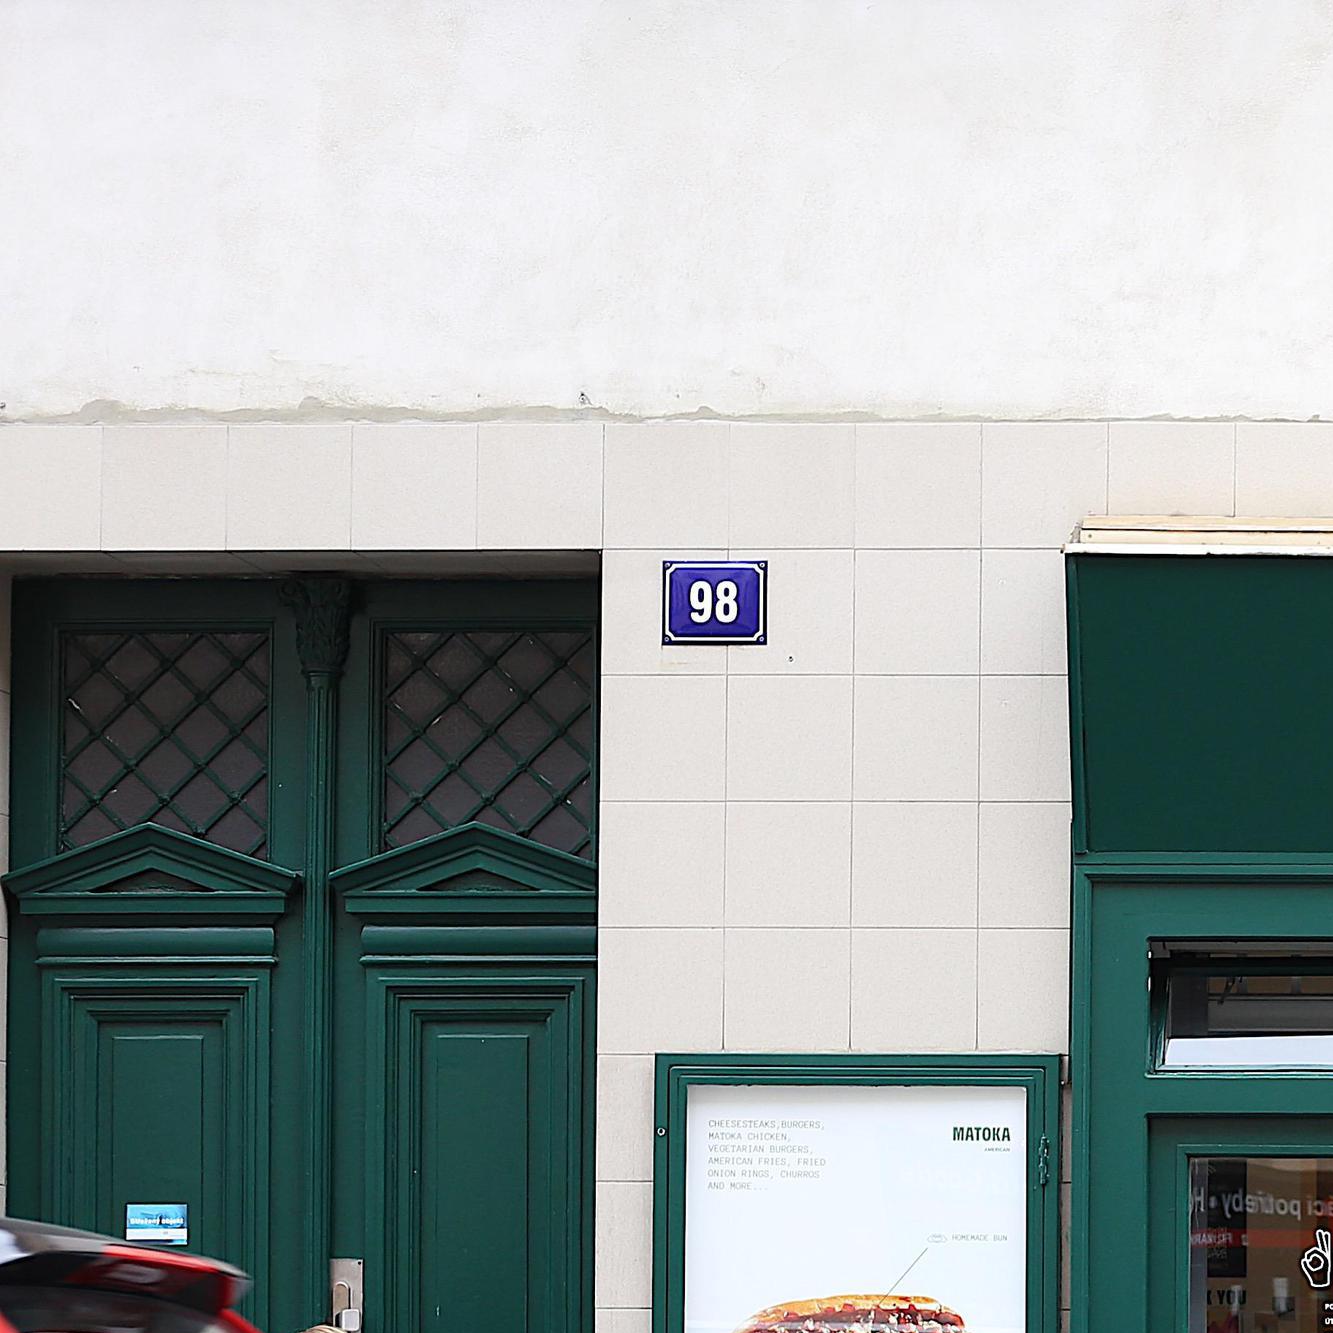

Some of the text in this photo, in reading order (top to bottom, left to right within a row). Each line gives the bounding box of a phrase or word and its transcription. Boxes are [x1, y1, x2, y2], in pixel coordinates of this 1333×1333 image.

[689, 579, 738, 624] 98
[708, 1132, 792, 1142] MATOKA CHICKEN,
[951, 1126, 1011, 1142] MATOKA
[707, 1144, 814, 1155] VEGETARIAN BURGERS,
[707, 1157, 827, 1167] AMERICAN FRIES, FRIED
[707, 1169, 821, 1180] ONION RINGS, CHURROS
[707, 1182, 725, 1190] AND
